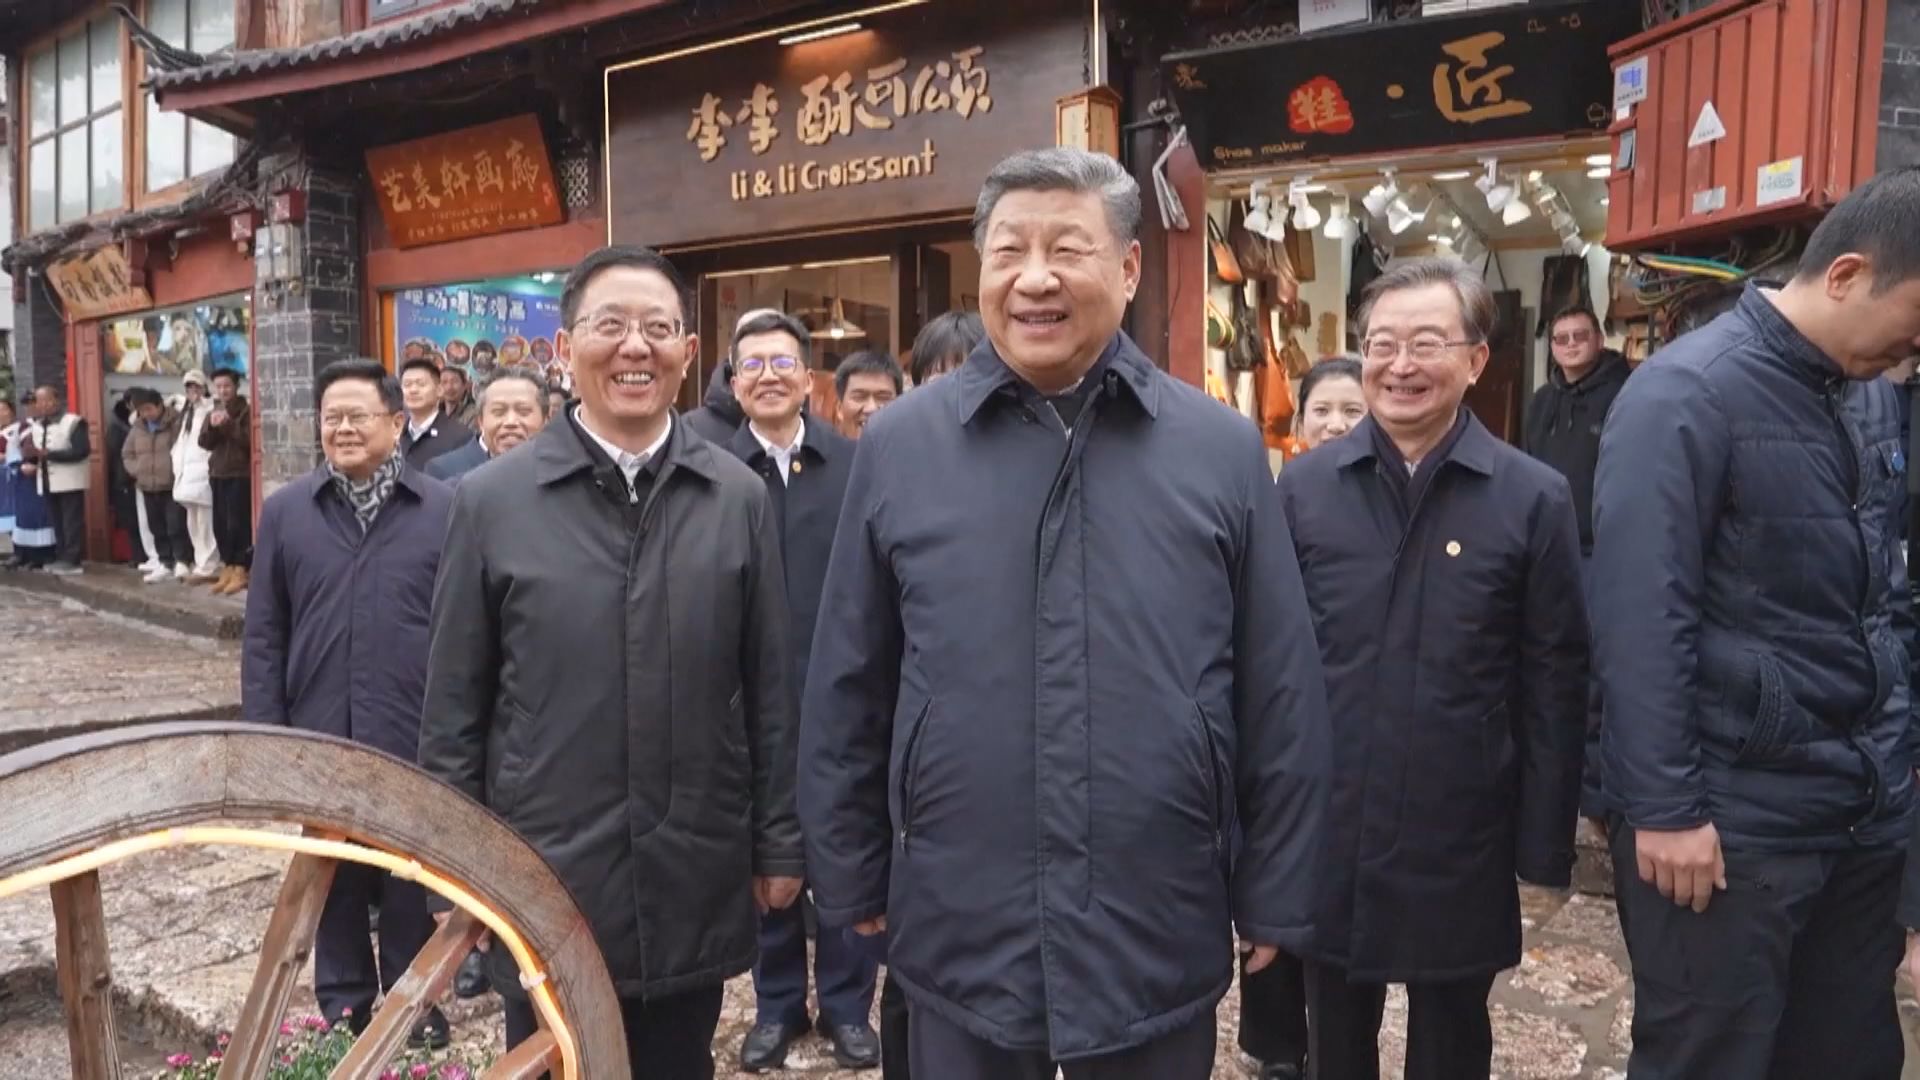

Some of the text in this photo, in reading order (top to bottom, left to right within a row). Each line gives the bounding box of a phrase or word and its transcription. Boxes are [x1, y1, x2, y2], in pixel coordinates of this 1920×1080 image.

[1261, 140, 1307, 155] maker
[753, 170, 773, 198] &
[779, 162, 796, 194] li
[801, 137, 937, 191] Croissant
